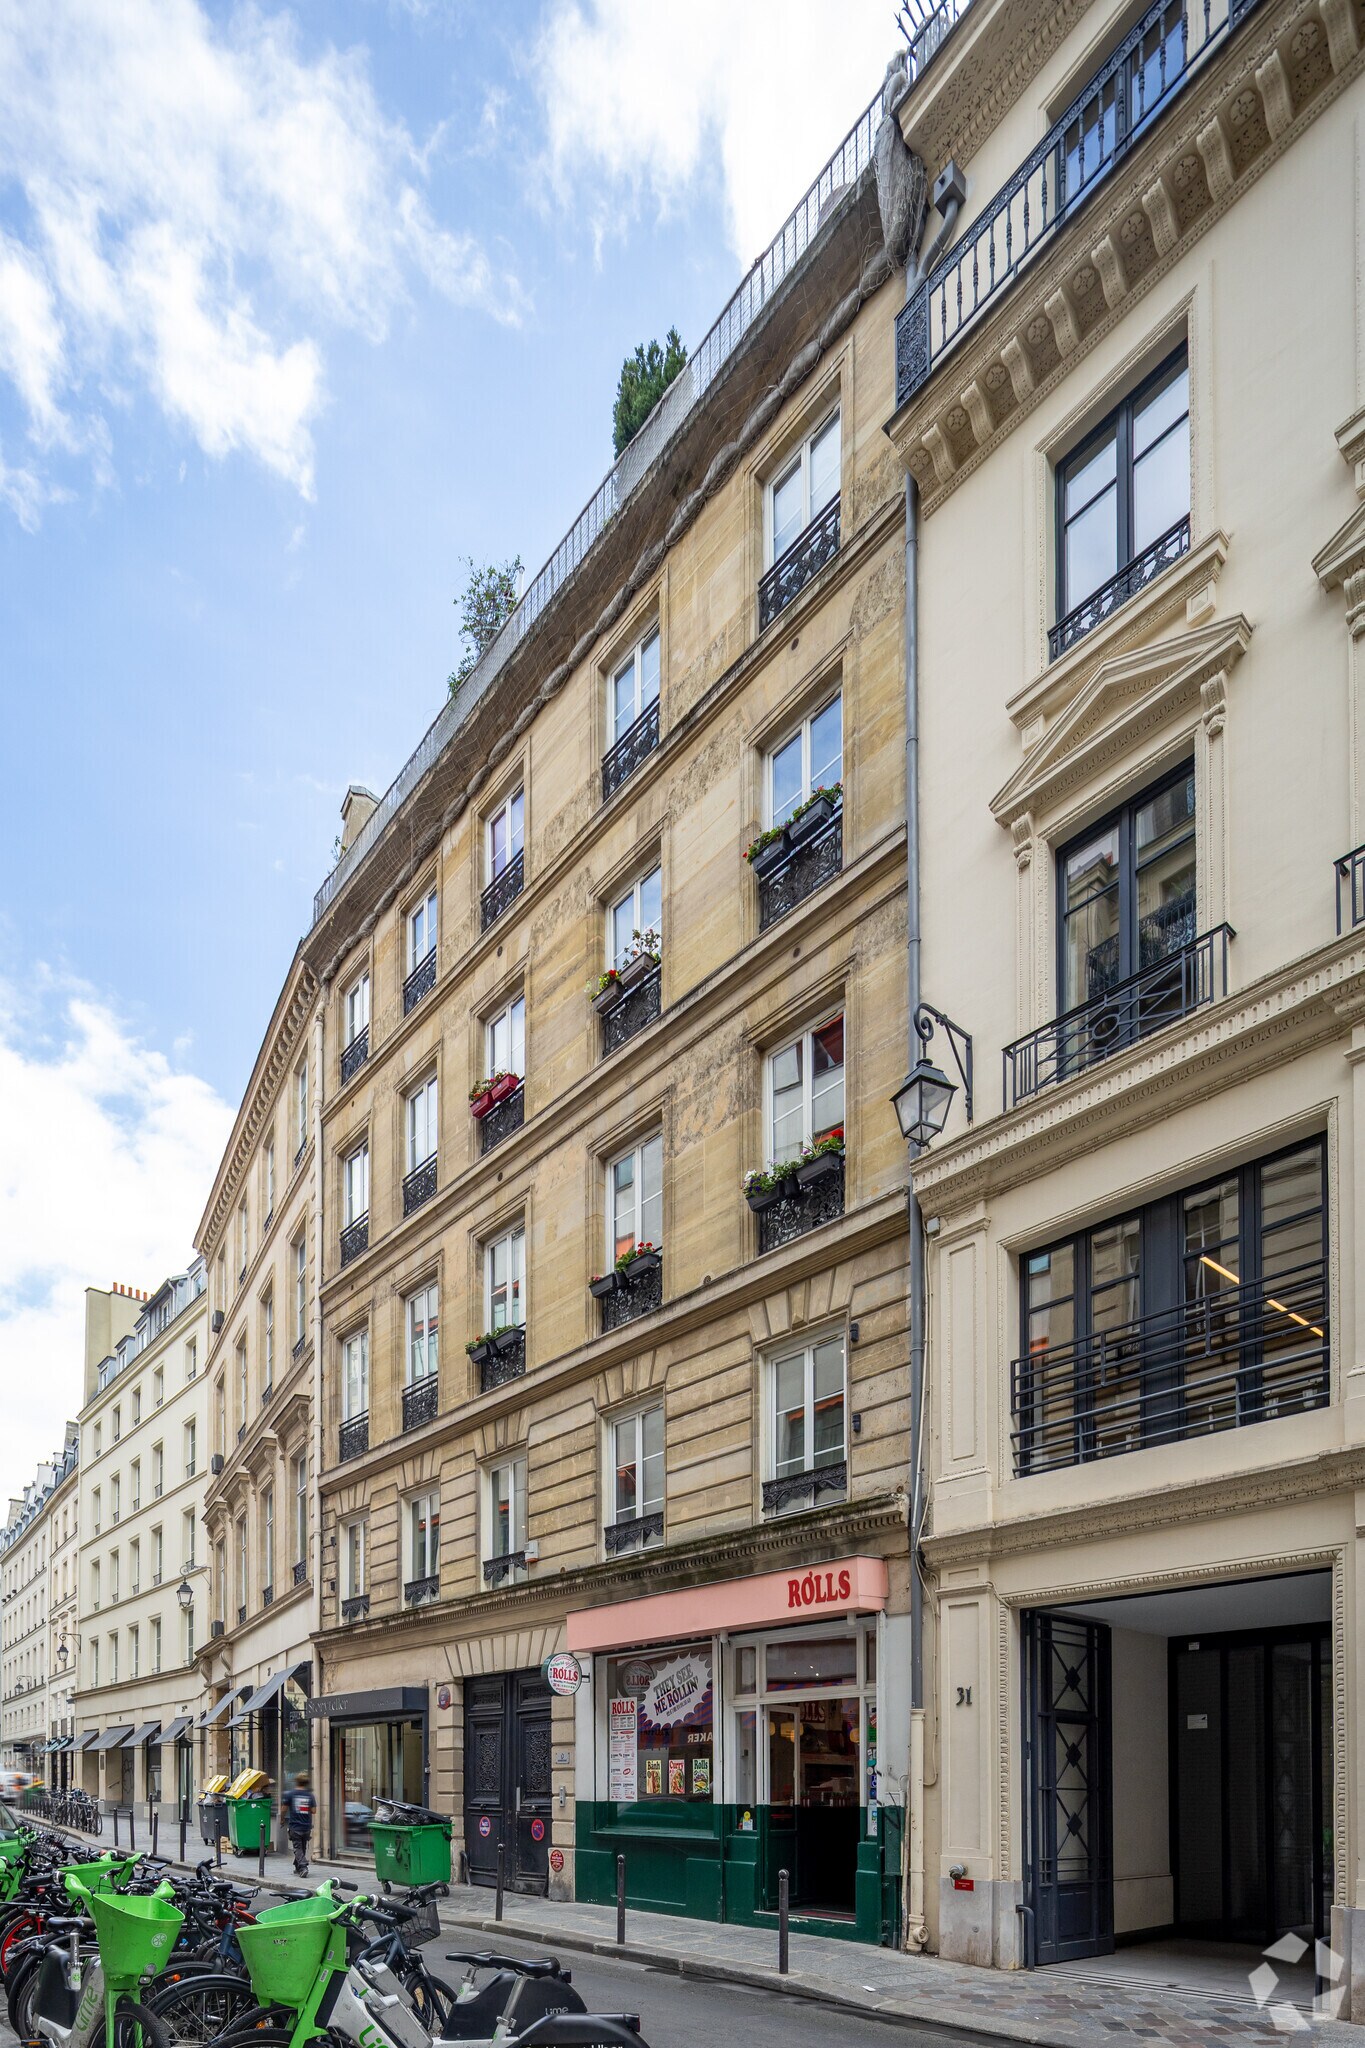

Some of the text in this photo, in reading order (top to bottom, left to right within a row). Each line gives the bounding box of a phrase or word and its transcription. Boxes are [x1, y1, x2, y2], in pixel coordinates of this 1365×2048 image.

[653, 1663, 693, 1699] THEY SEE
[654, 1697, 668, 1716] ME
